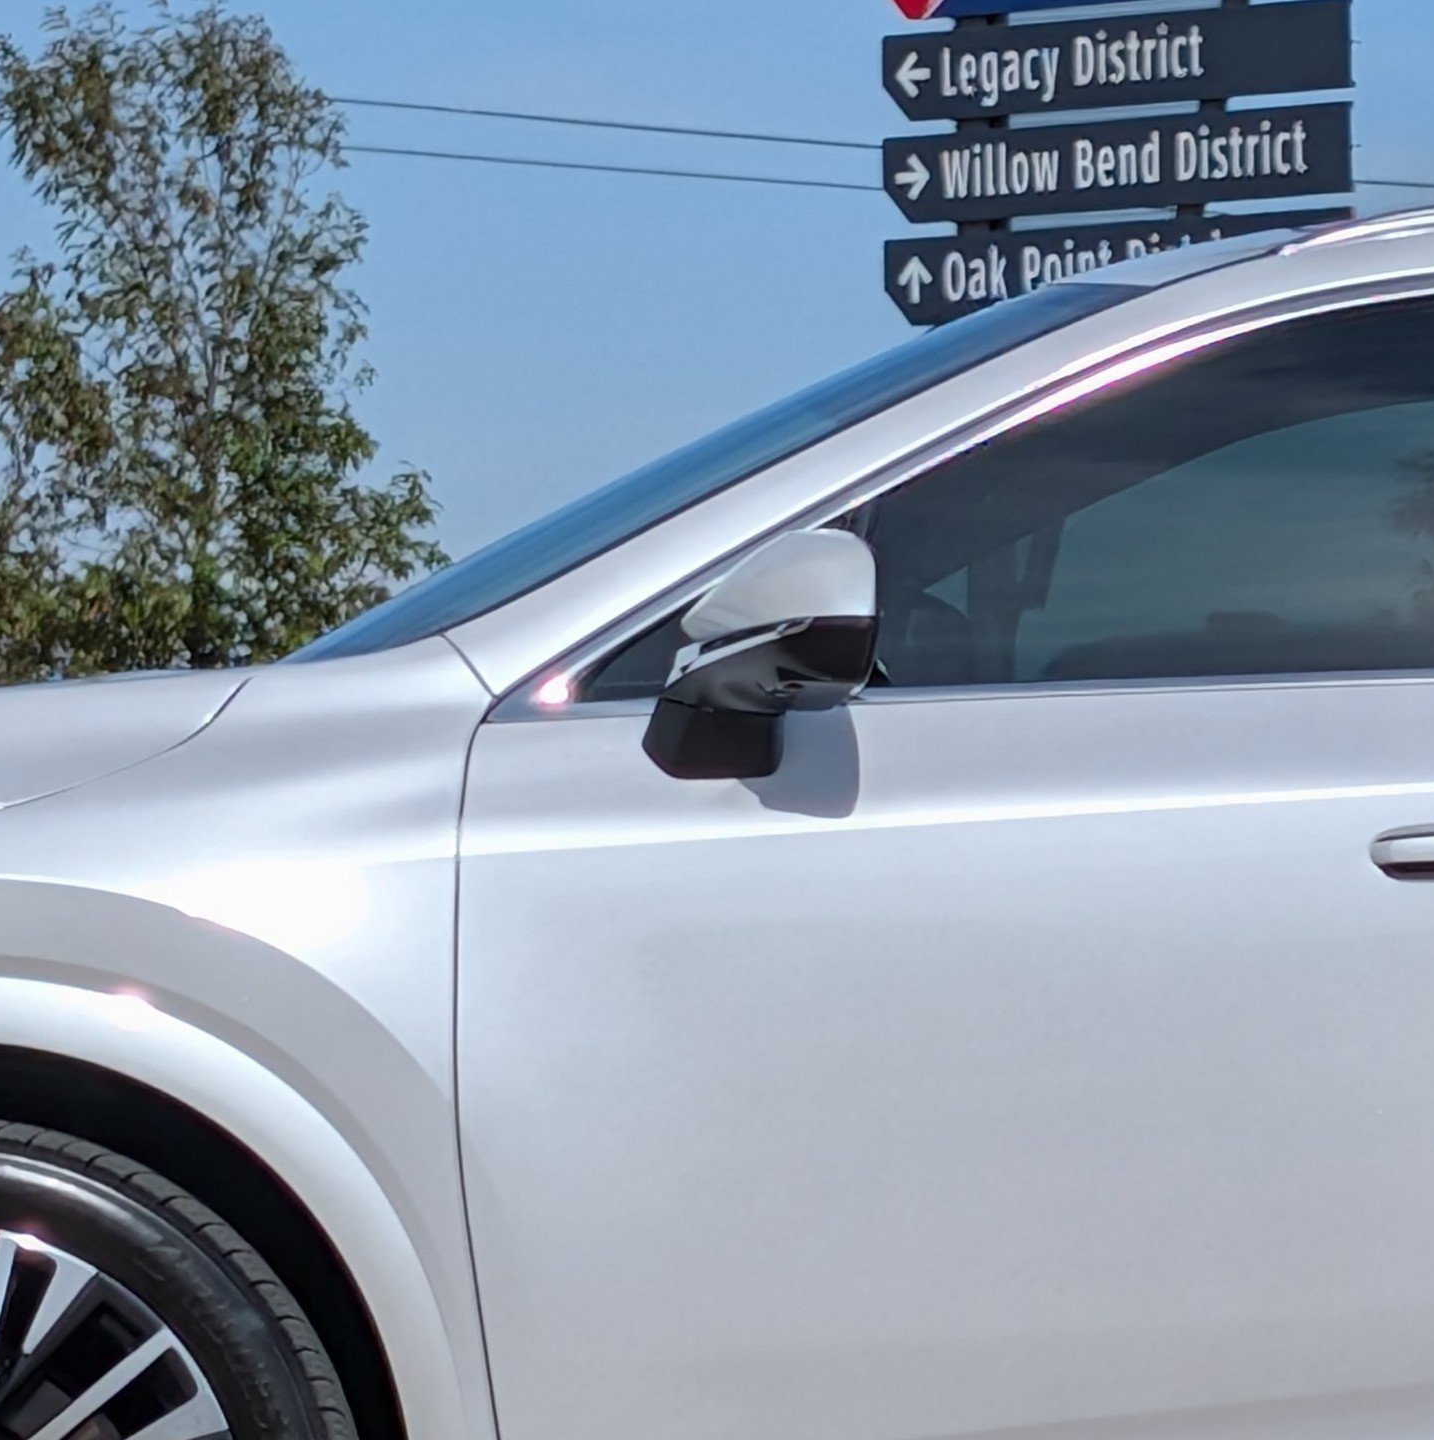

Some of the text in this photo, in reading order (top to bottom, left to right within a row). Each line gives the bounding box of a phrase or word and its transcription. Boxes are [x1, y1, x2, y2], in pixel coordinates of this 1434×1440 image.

[940, 22, 1205, 107] Legacy District
[939, 120, 1309, 200] Willow Bend District
[943, 244, 1008, 303] Oak
